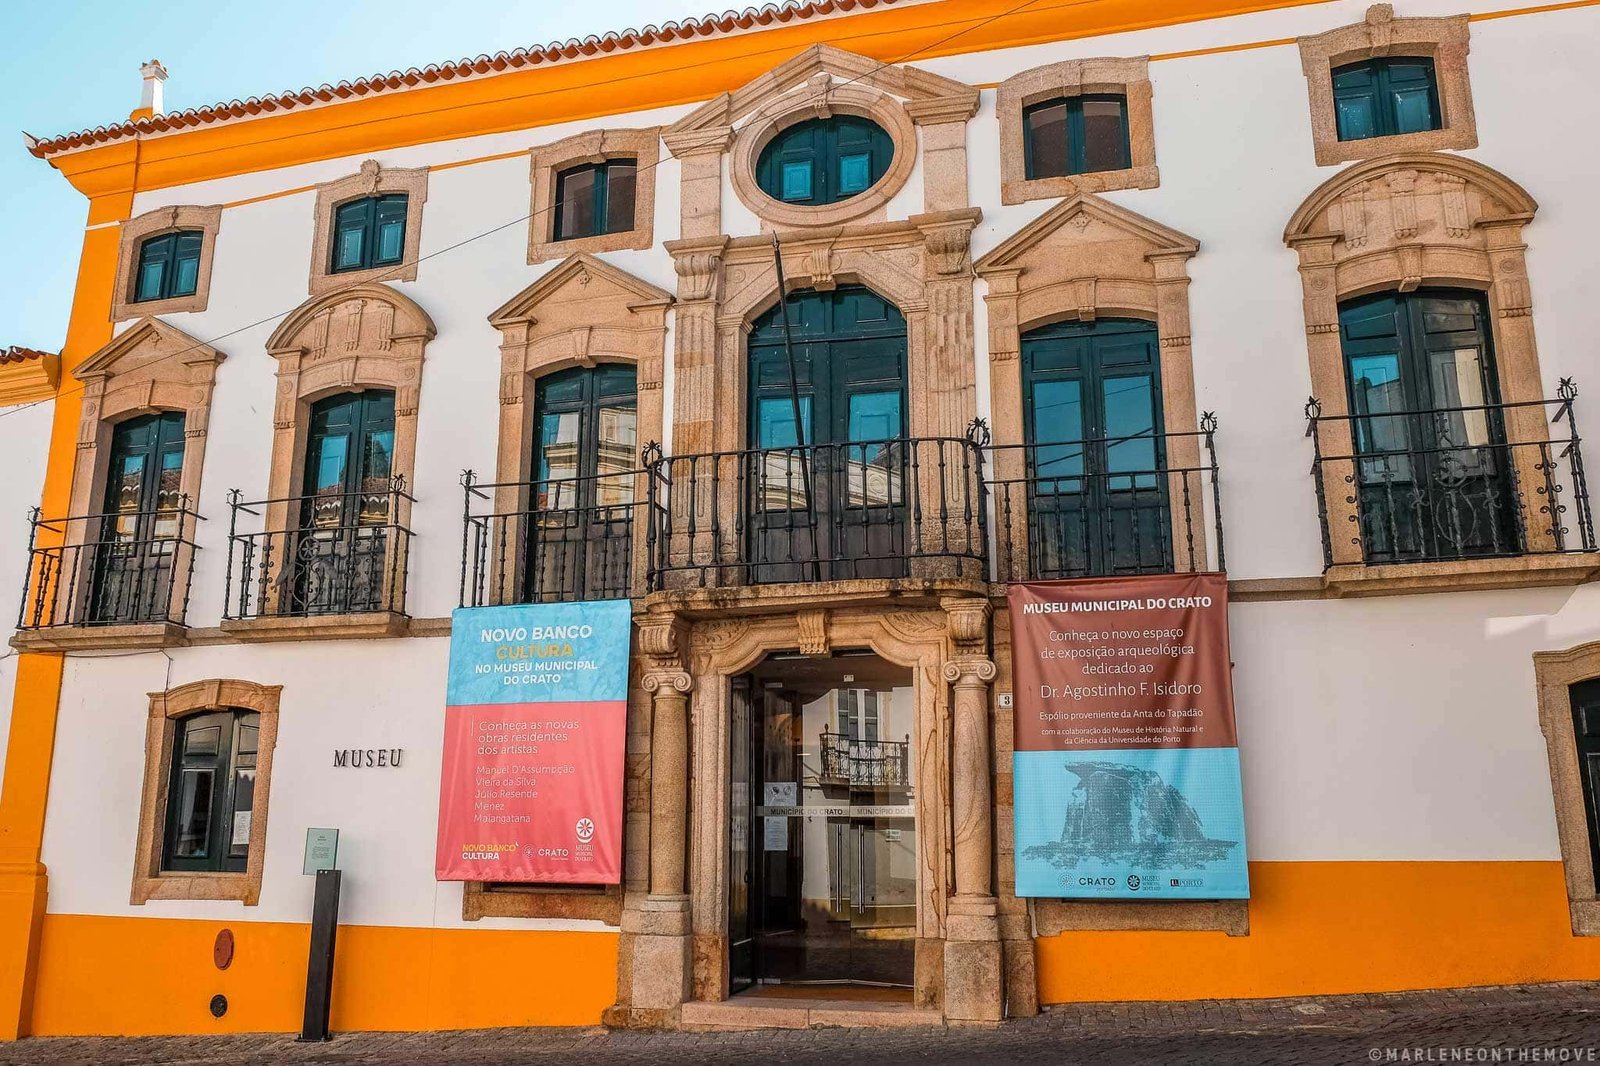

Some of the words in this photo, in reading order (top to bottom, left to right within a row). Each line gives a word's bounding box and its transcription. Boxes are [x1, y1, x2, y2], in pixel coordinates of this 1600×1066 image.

[1023, 602, 1069, 614] MUSEU
[1070, 599, 1144, 612] MUNICIPAL
[1146, 598, 1166, 610] DO
[1168, 596, 1212, 608] CRATO
[481, 628, 527, 643] NOVO
[532, 625, 592, 641] BANCO
[1049, 630, 1098, 643] Conheça
[1102, 632, 1109, 640] o
[1112, 630, 1140, 640] novo
[1143, 628, 1184, 641] espaço
[496, 644, 574, 660] CULTURA
[1041, 648, 1054, 659] de
[1058, 646, 1115, 661] exposição
[1118, 644, 1194, 659] arqueológica
[475, 664, 491, 674] NO
[494, 662, 532, 674] MUSEU
[534, 660, 598, 672] MUNICIPAL
[1082, 663, 1136, 675] dedicado
[1139, 664, 1154, 673] ao
[504, 675, 520, 685] DO
[522, 674, 560, 684] CRATO
[1040, 685, 1059, 699] Dr.
[1063, 683, 1136, 700] Agostinho
[1140, 683, 1150, 696] F.
[1153, 682, 1202, 695] Isidoro
[1004, 696, 1010, 705] 3
[1040, 712, 1069, 722] Espólio
[1070, 711, 1119, 721] proveniente
[1120, 710, 1132, 718] da
[1133, 710, 1153, 718] Anta
[1154, 710, 1166, 718] do
[1168, 708, 1203, 718] Tapadão
[479, 720, 527, 733] Conheça
[530, 722, 542, 730] as
[546, 720, 580, 730] novas
[1062, 727, 1102, 736] colaboração
[478, 732, 508, 743] obras
[512, 731, 568, 742] residentes
[477, 745, 498, 755] dos
[500, 744, 538, 754] artistas
[334, 748, 402, 768] MUSEU
[476, 766, 509, 775] Manuel
[476, 778, 500, 787] Vieira
[503, 778, 514, 786] da
[516, 776, 536, 786] Silva
[500, 790, 538, 798] Resende
[474, 814, 531, 825] Malangatana
[462, 852, 500, 860] CULTURA
[538, 848, 568, 857] CRATO
[1078, 877, 1116, 886] CRATO
